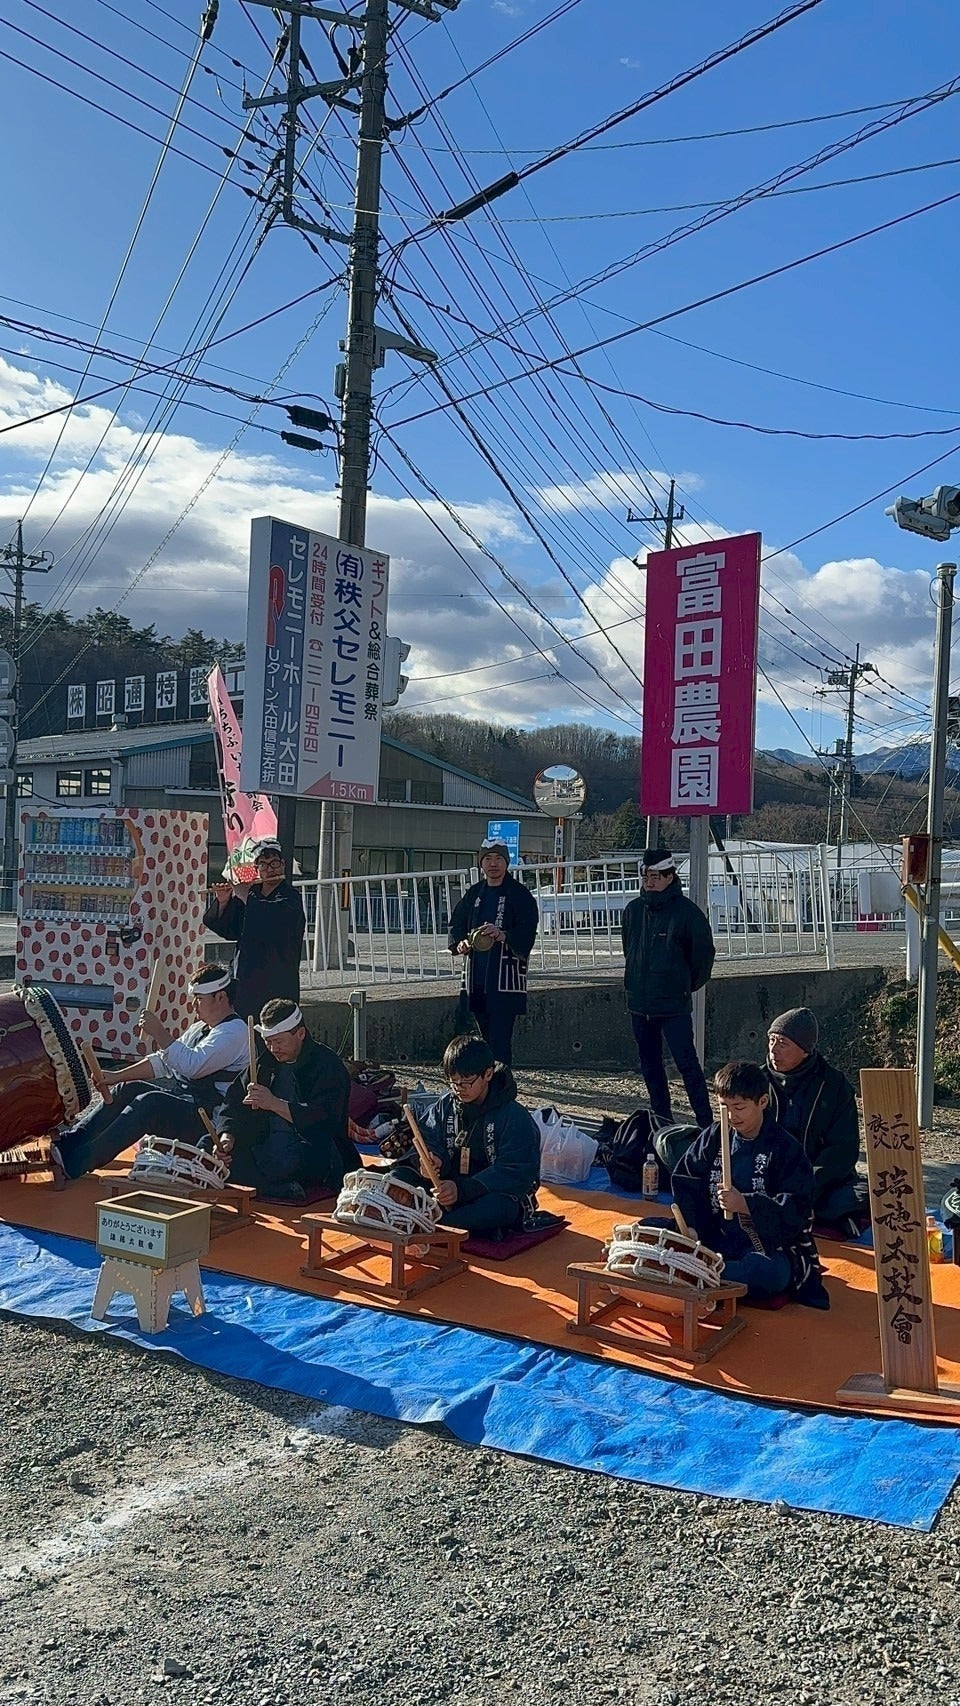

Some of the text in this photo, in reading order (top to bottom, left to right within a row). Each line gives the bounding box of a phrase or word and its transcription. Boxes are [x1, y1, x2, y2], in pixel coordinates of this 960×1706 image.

[309, 542, 328, 626] 24時間受付
[327, 549, 364, 767] (有)秩父セレモニー
[363, 559, 386, 721] ギフト&総合葬祭
[261, 647, 281, 784] Uターン大田信号左折
[278, 535, 307, 786] セレモニーホール大田
[670, 552, 726, 808] 富田農園
[329, 782, 367, 800] 1.5Km
[101, 1217, 164, 1239] ありがとうございます
